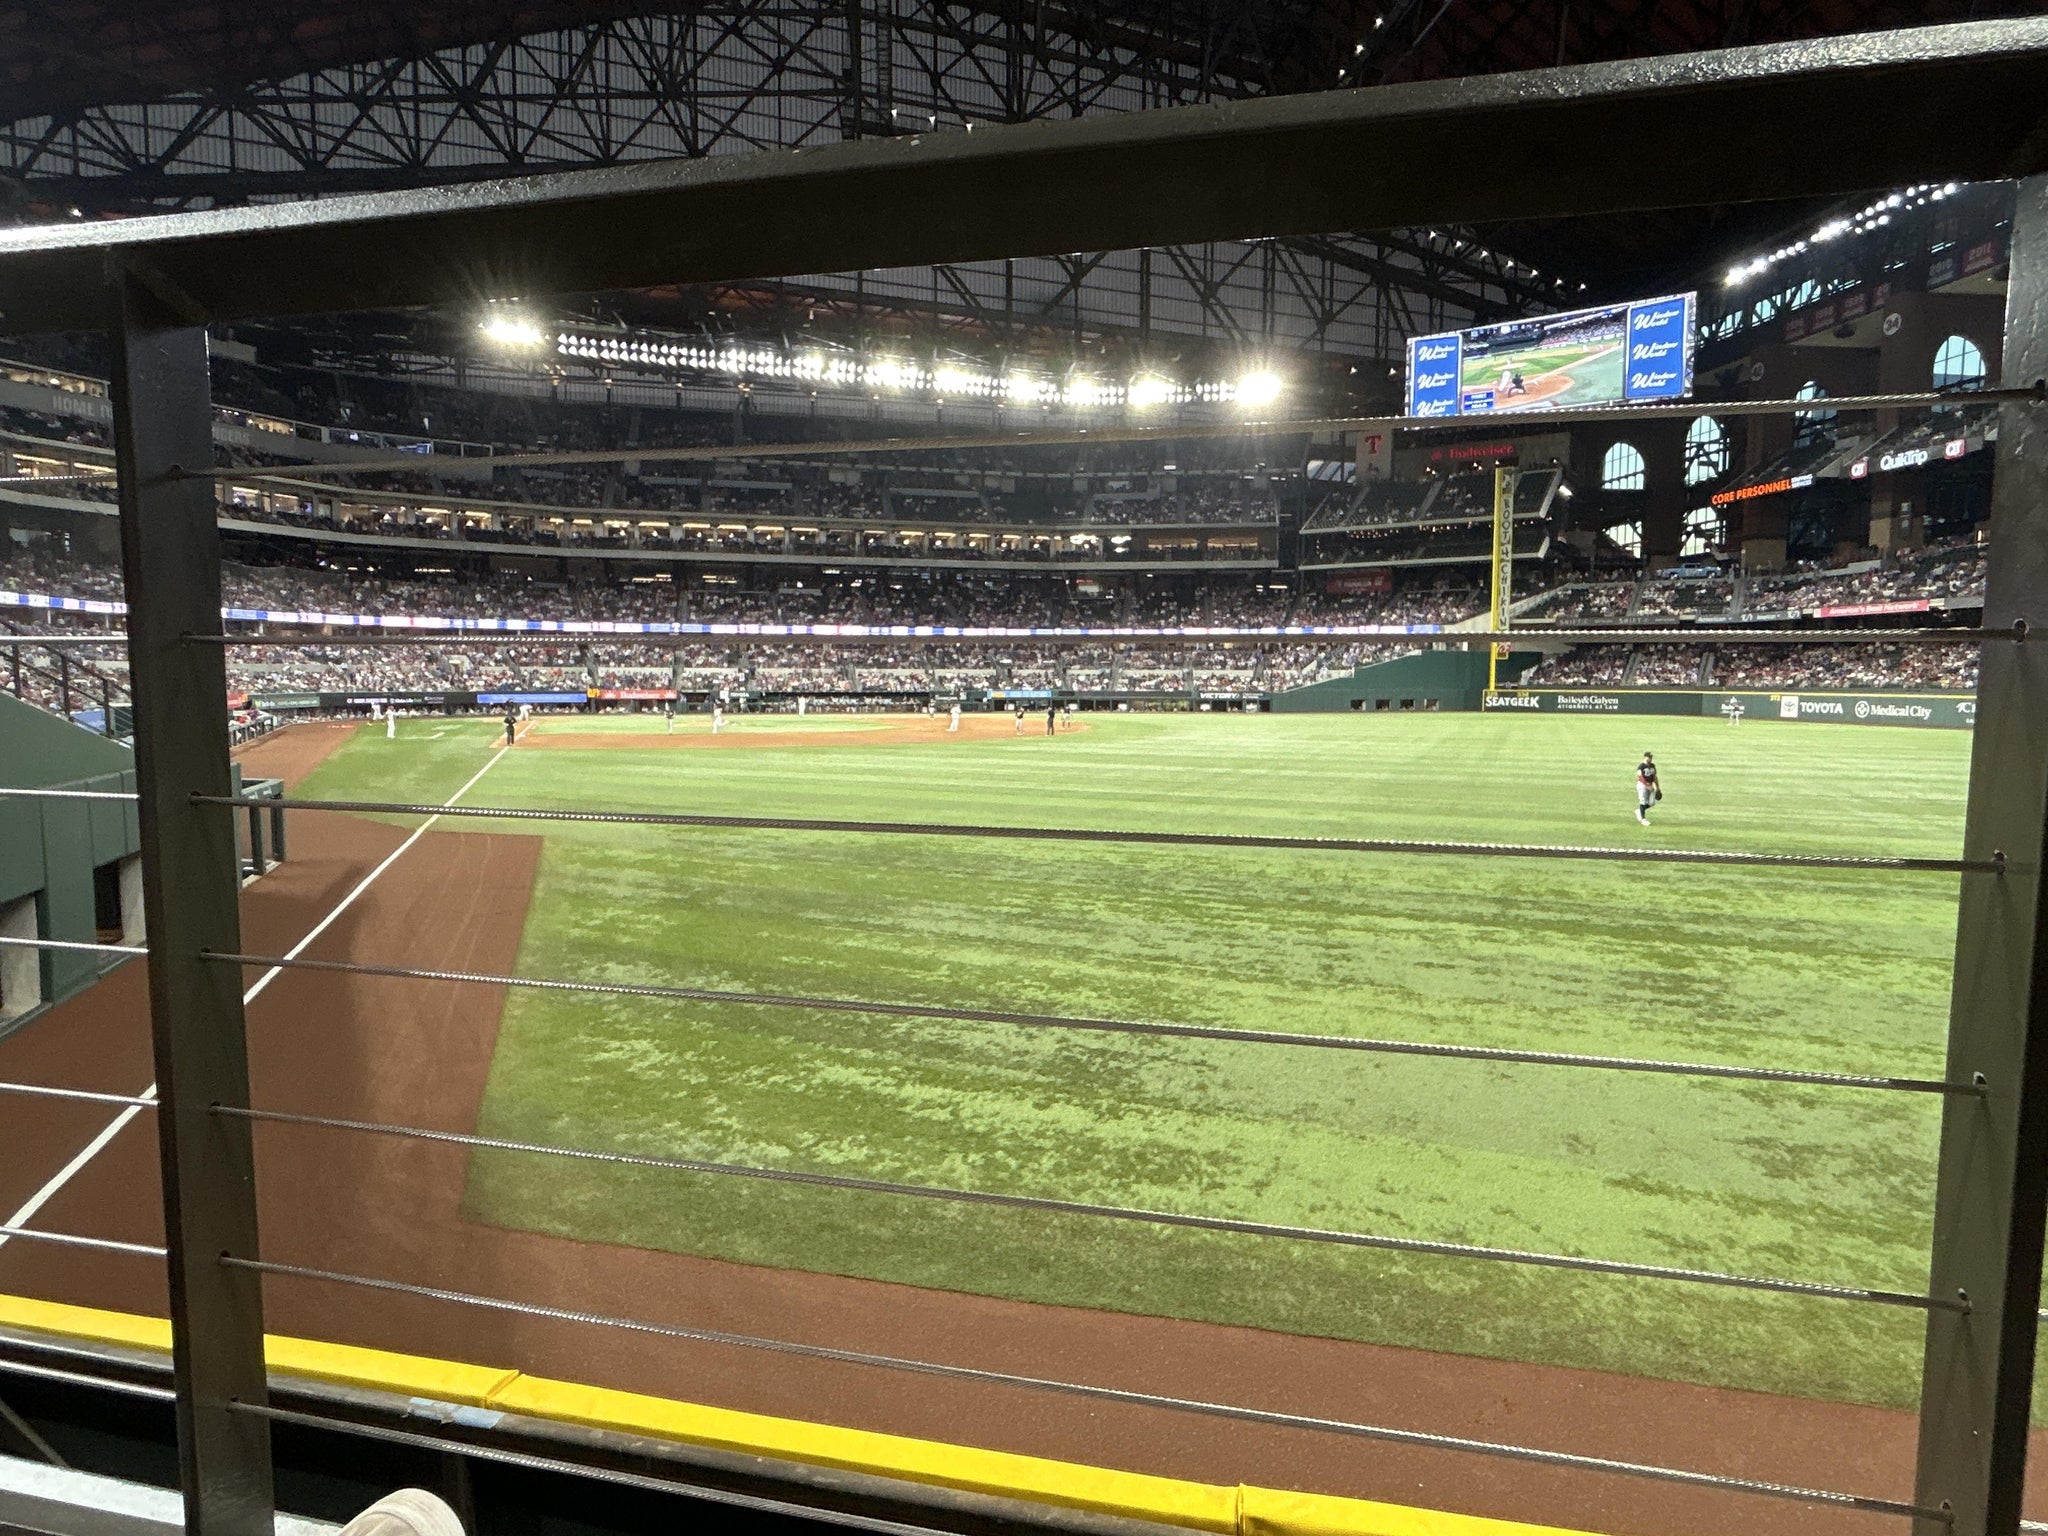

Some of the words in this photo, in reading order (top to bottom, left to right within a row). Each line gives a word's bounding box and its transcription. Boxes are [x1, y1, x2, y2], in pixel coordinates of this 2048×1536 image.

[53, 395, 95, 417] HOME
[1365, 435, 1382, 454] T
[1450, 445, 1514, 458] Budweiser
[1880, 449, 1928, 470] QuikTrip
[1712, 491, 1735, 505] CORE
[1736, 479, 1791, 500] PERSONNEL
[1485, 696, 1540, 708] SEATGEEK
[1800, 702, 1843, 714] TOYOTA
[1870, 704, 1909, 717] Medical
[1909, 705, 1932, 720] City
